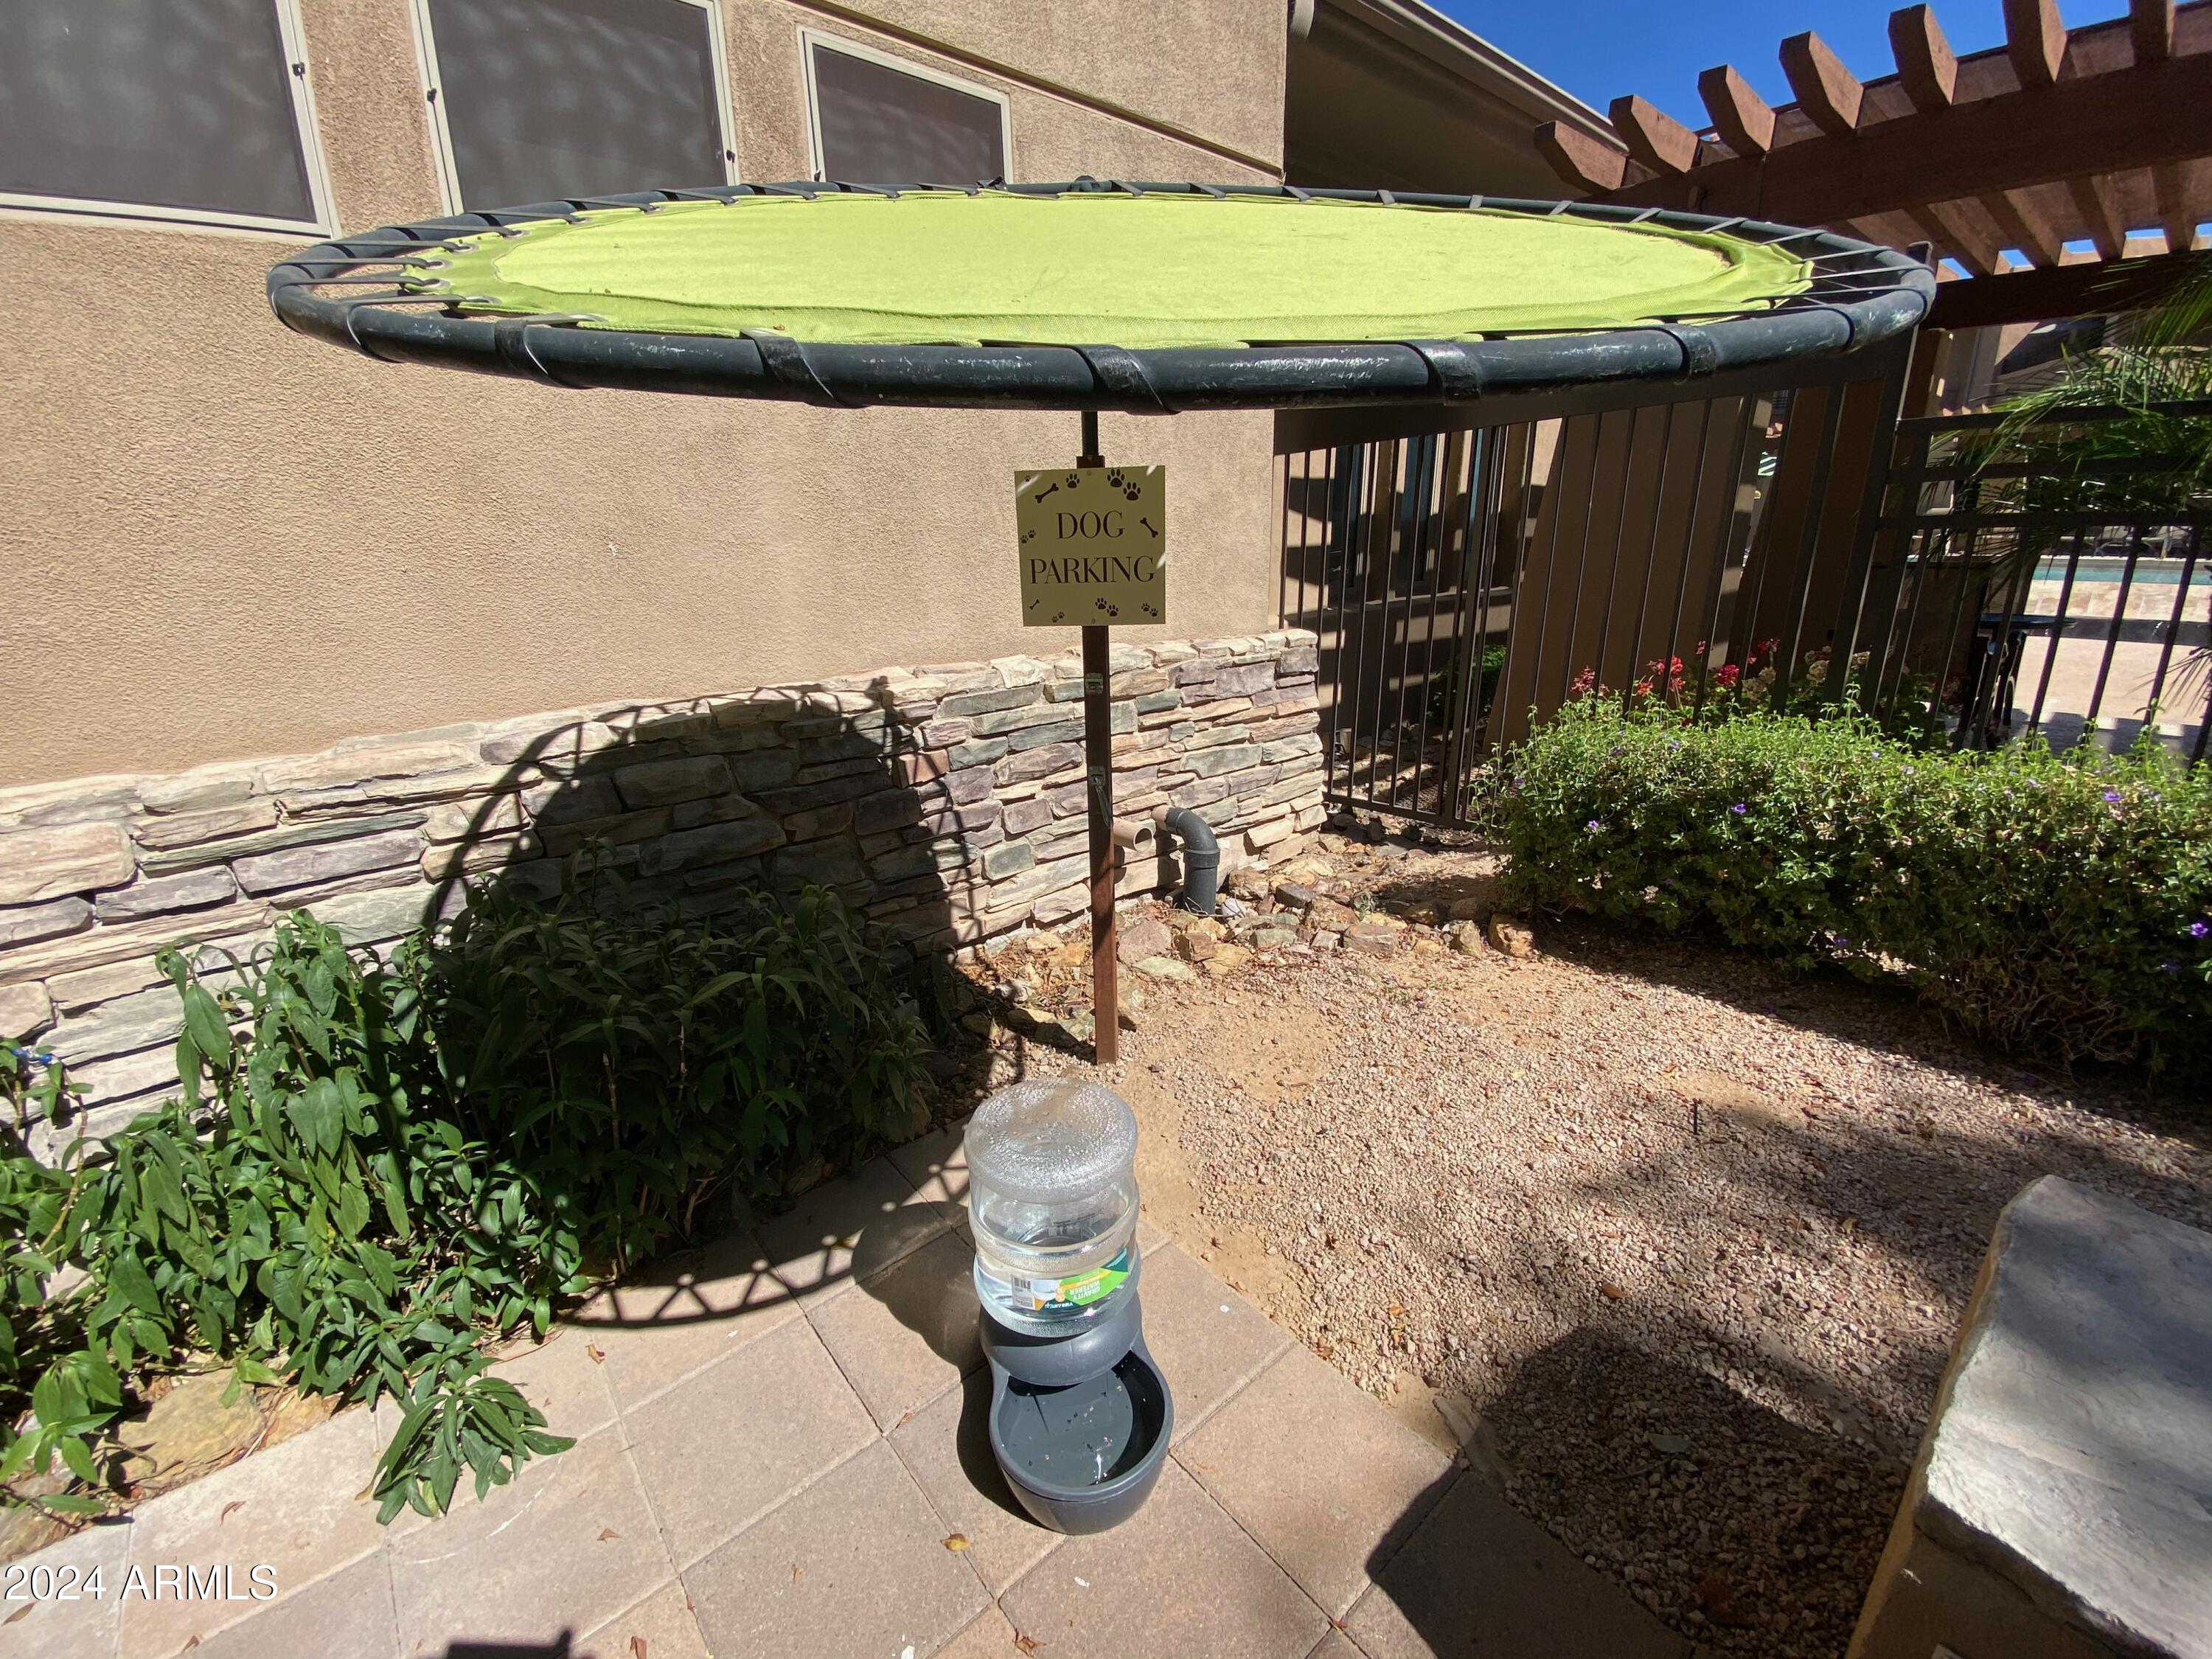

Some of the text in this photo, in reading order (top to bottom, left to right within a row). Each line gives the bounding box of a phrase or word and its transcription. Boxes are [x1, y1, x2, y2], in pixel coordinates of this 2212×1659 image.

[1056, 510, 1126, 539] DOG
[1029, 555, 1156, 584] PARKING
[1069, 1280, 1100, 1295] WATERER
[1073, 1285, 1100, 1300] GRAVITY
